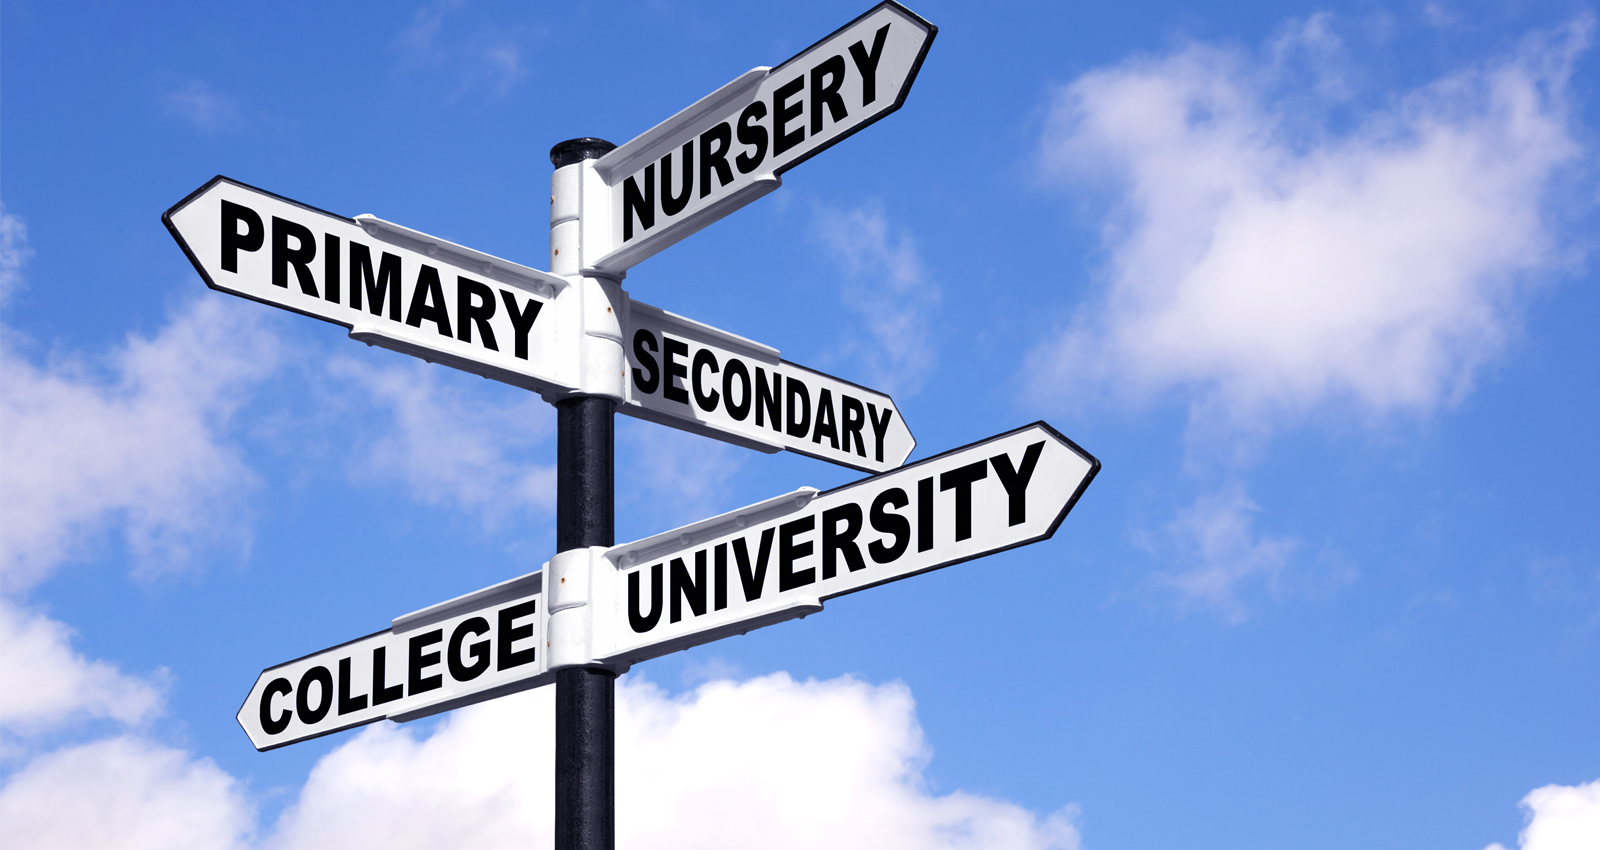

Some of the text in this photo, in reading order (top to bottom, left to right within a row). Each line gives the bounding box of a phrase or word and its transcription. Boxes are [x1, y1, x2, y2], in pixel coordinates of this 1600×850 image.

[623, 22, 892, 243] NURSERY
[221, 199, 544, 361] PRIMARY
[631, 328, 893, 463] SECONDARY
[627, 440, 1046, 633] UNIVERSITY
[259, 599, 536, 735] COLLEGE
